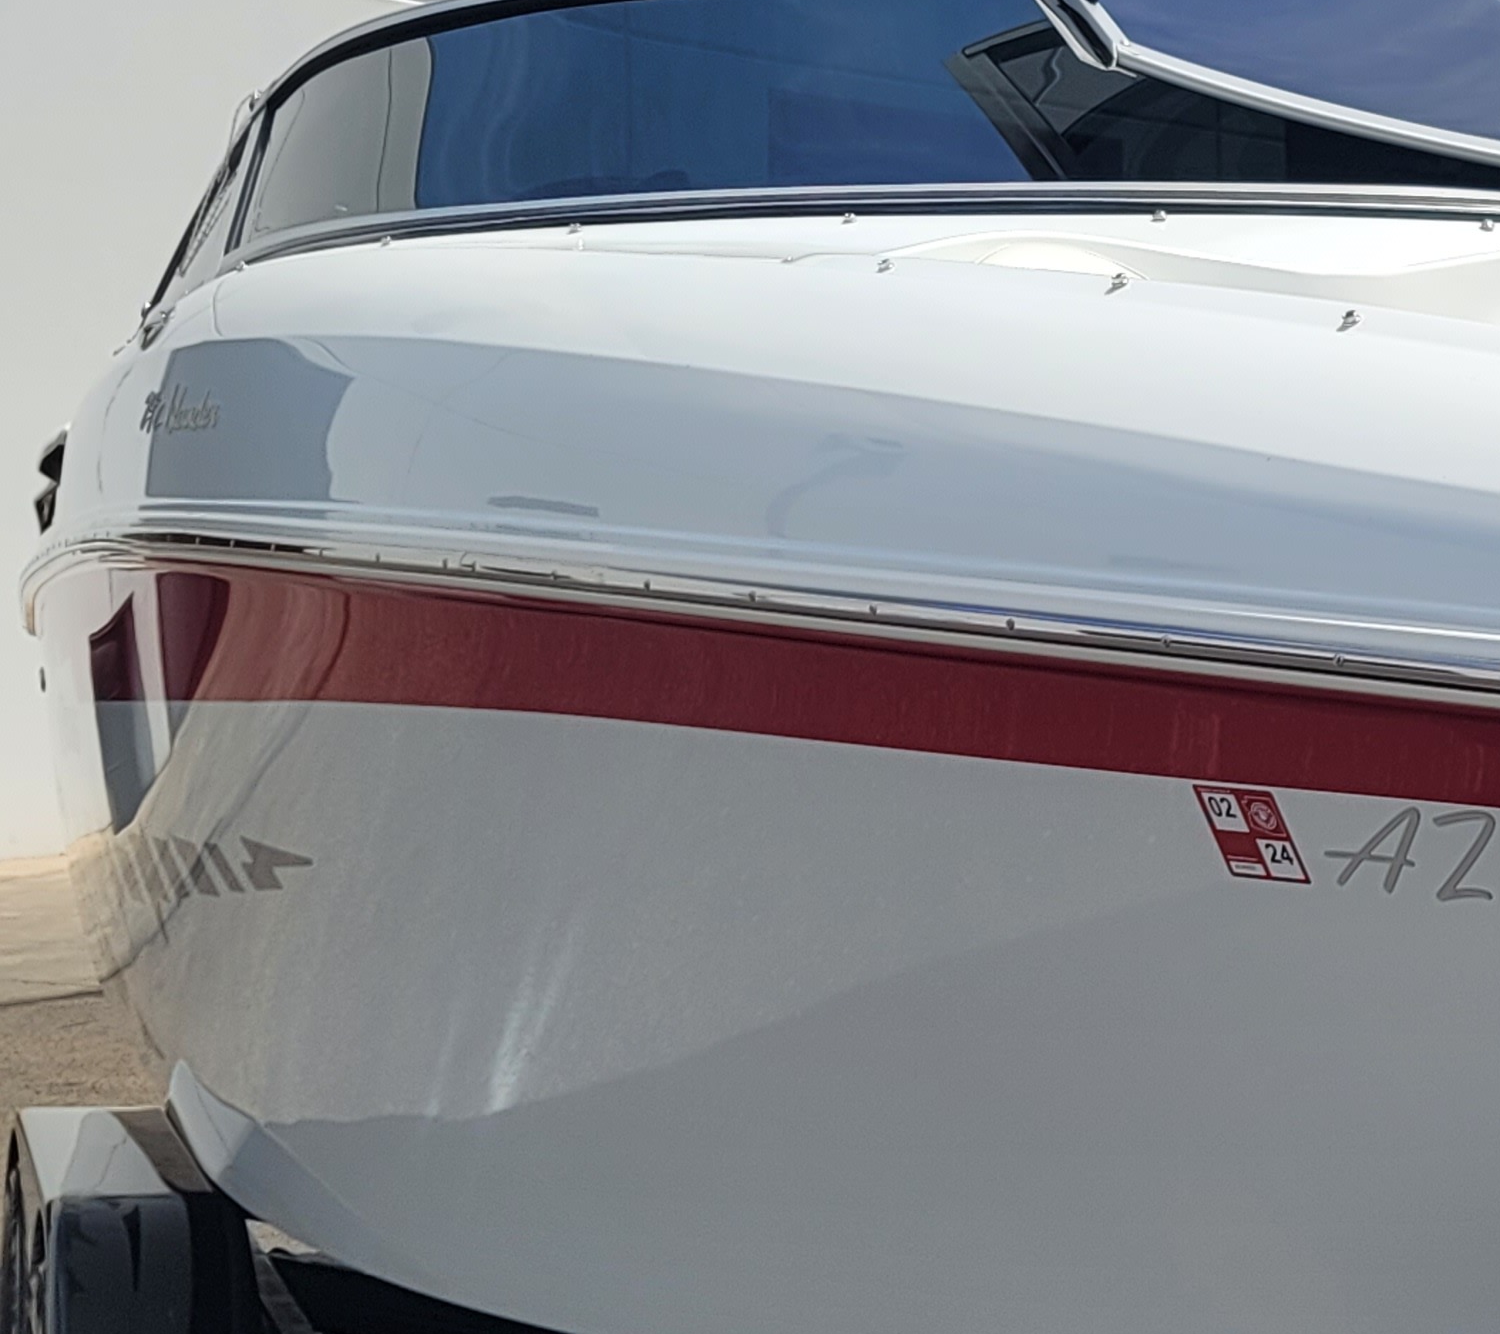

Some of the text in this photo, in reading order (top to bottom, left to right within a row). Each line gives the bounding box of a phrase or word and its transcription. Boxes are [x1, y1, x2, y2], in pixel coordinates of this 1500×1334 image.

[1208, 796, 1237, 818] 02
[1265, 843, 1294, 866] 24
[1324, 807, 1495, 901] AZ
